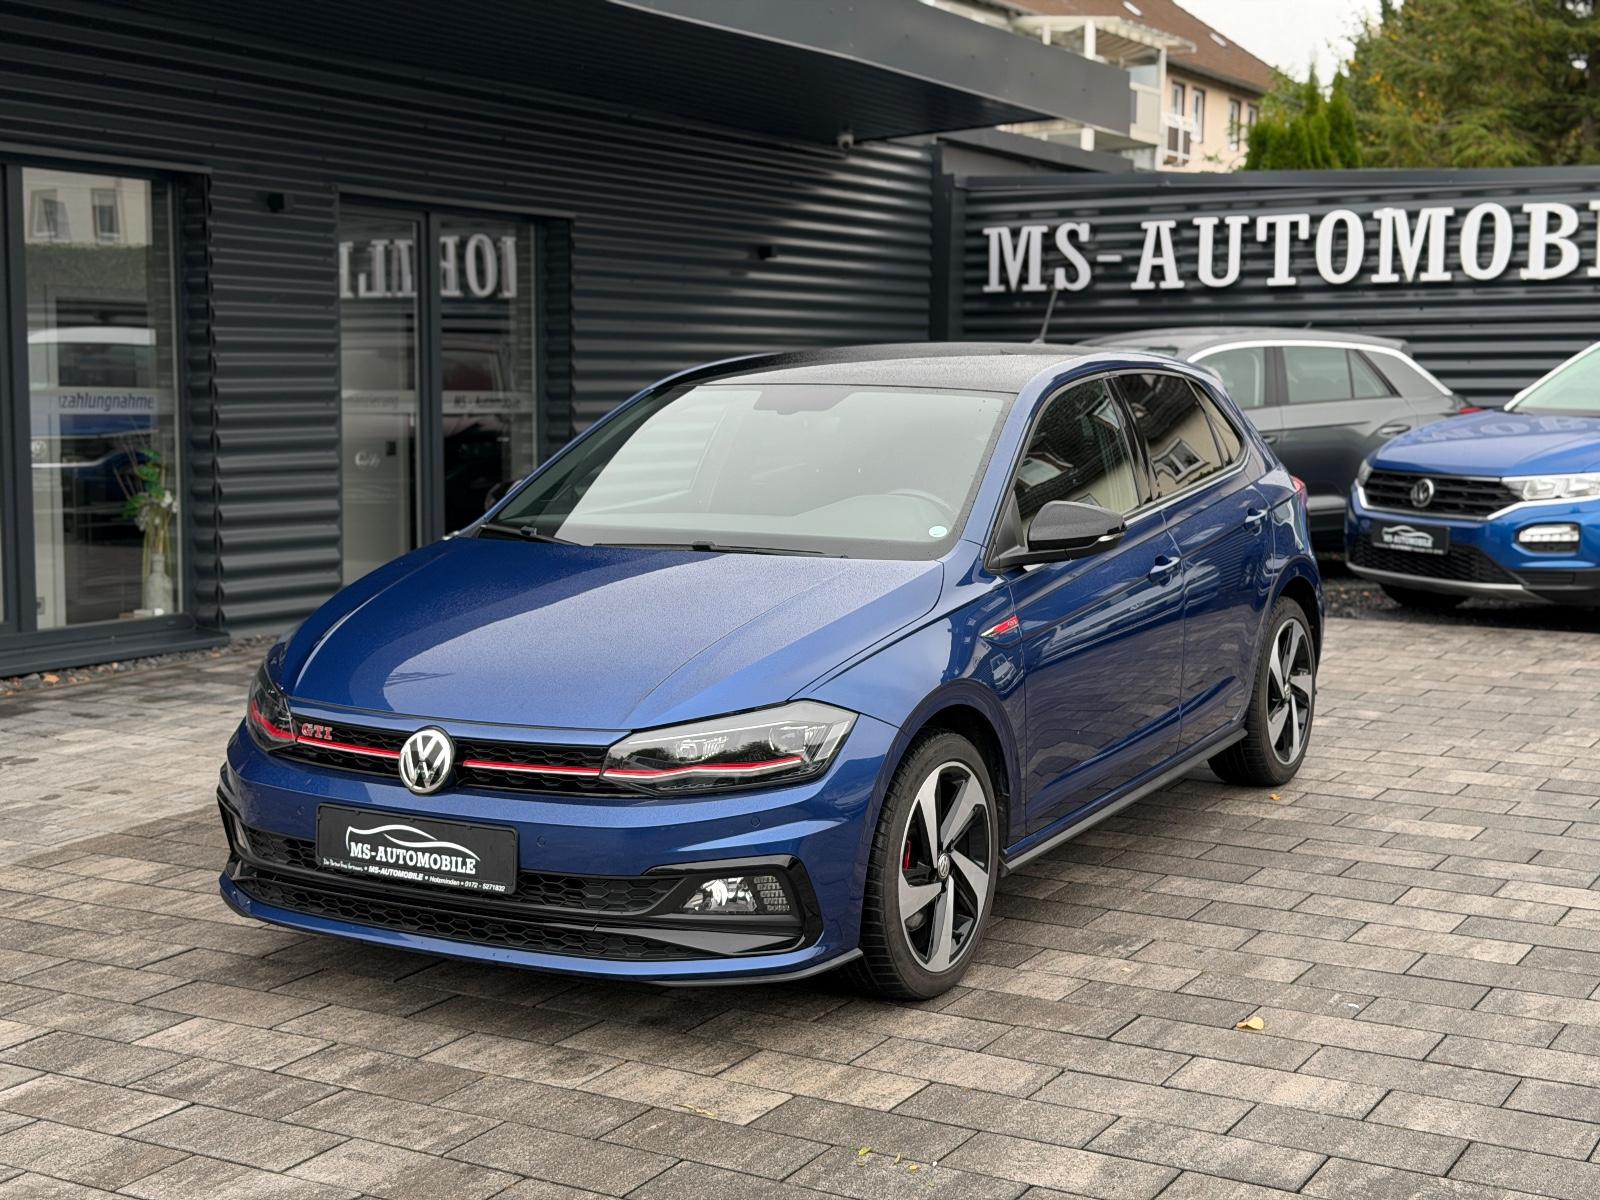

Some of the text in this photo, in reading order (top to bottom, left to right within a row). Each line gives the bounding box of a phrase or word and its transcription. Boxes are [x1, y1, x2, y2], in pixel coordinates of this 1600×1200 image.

[301, 722, 333, 740] GTI
[350, 841, 476, 875] MS-AUTOMOBILE
[368, 865, 424, 881] MS-AUTOMOBILE
[464, 880, 478, 889] 0172
